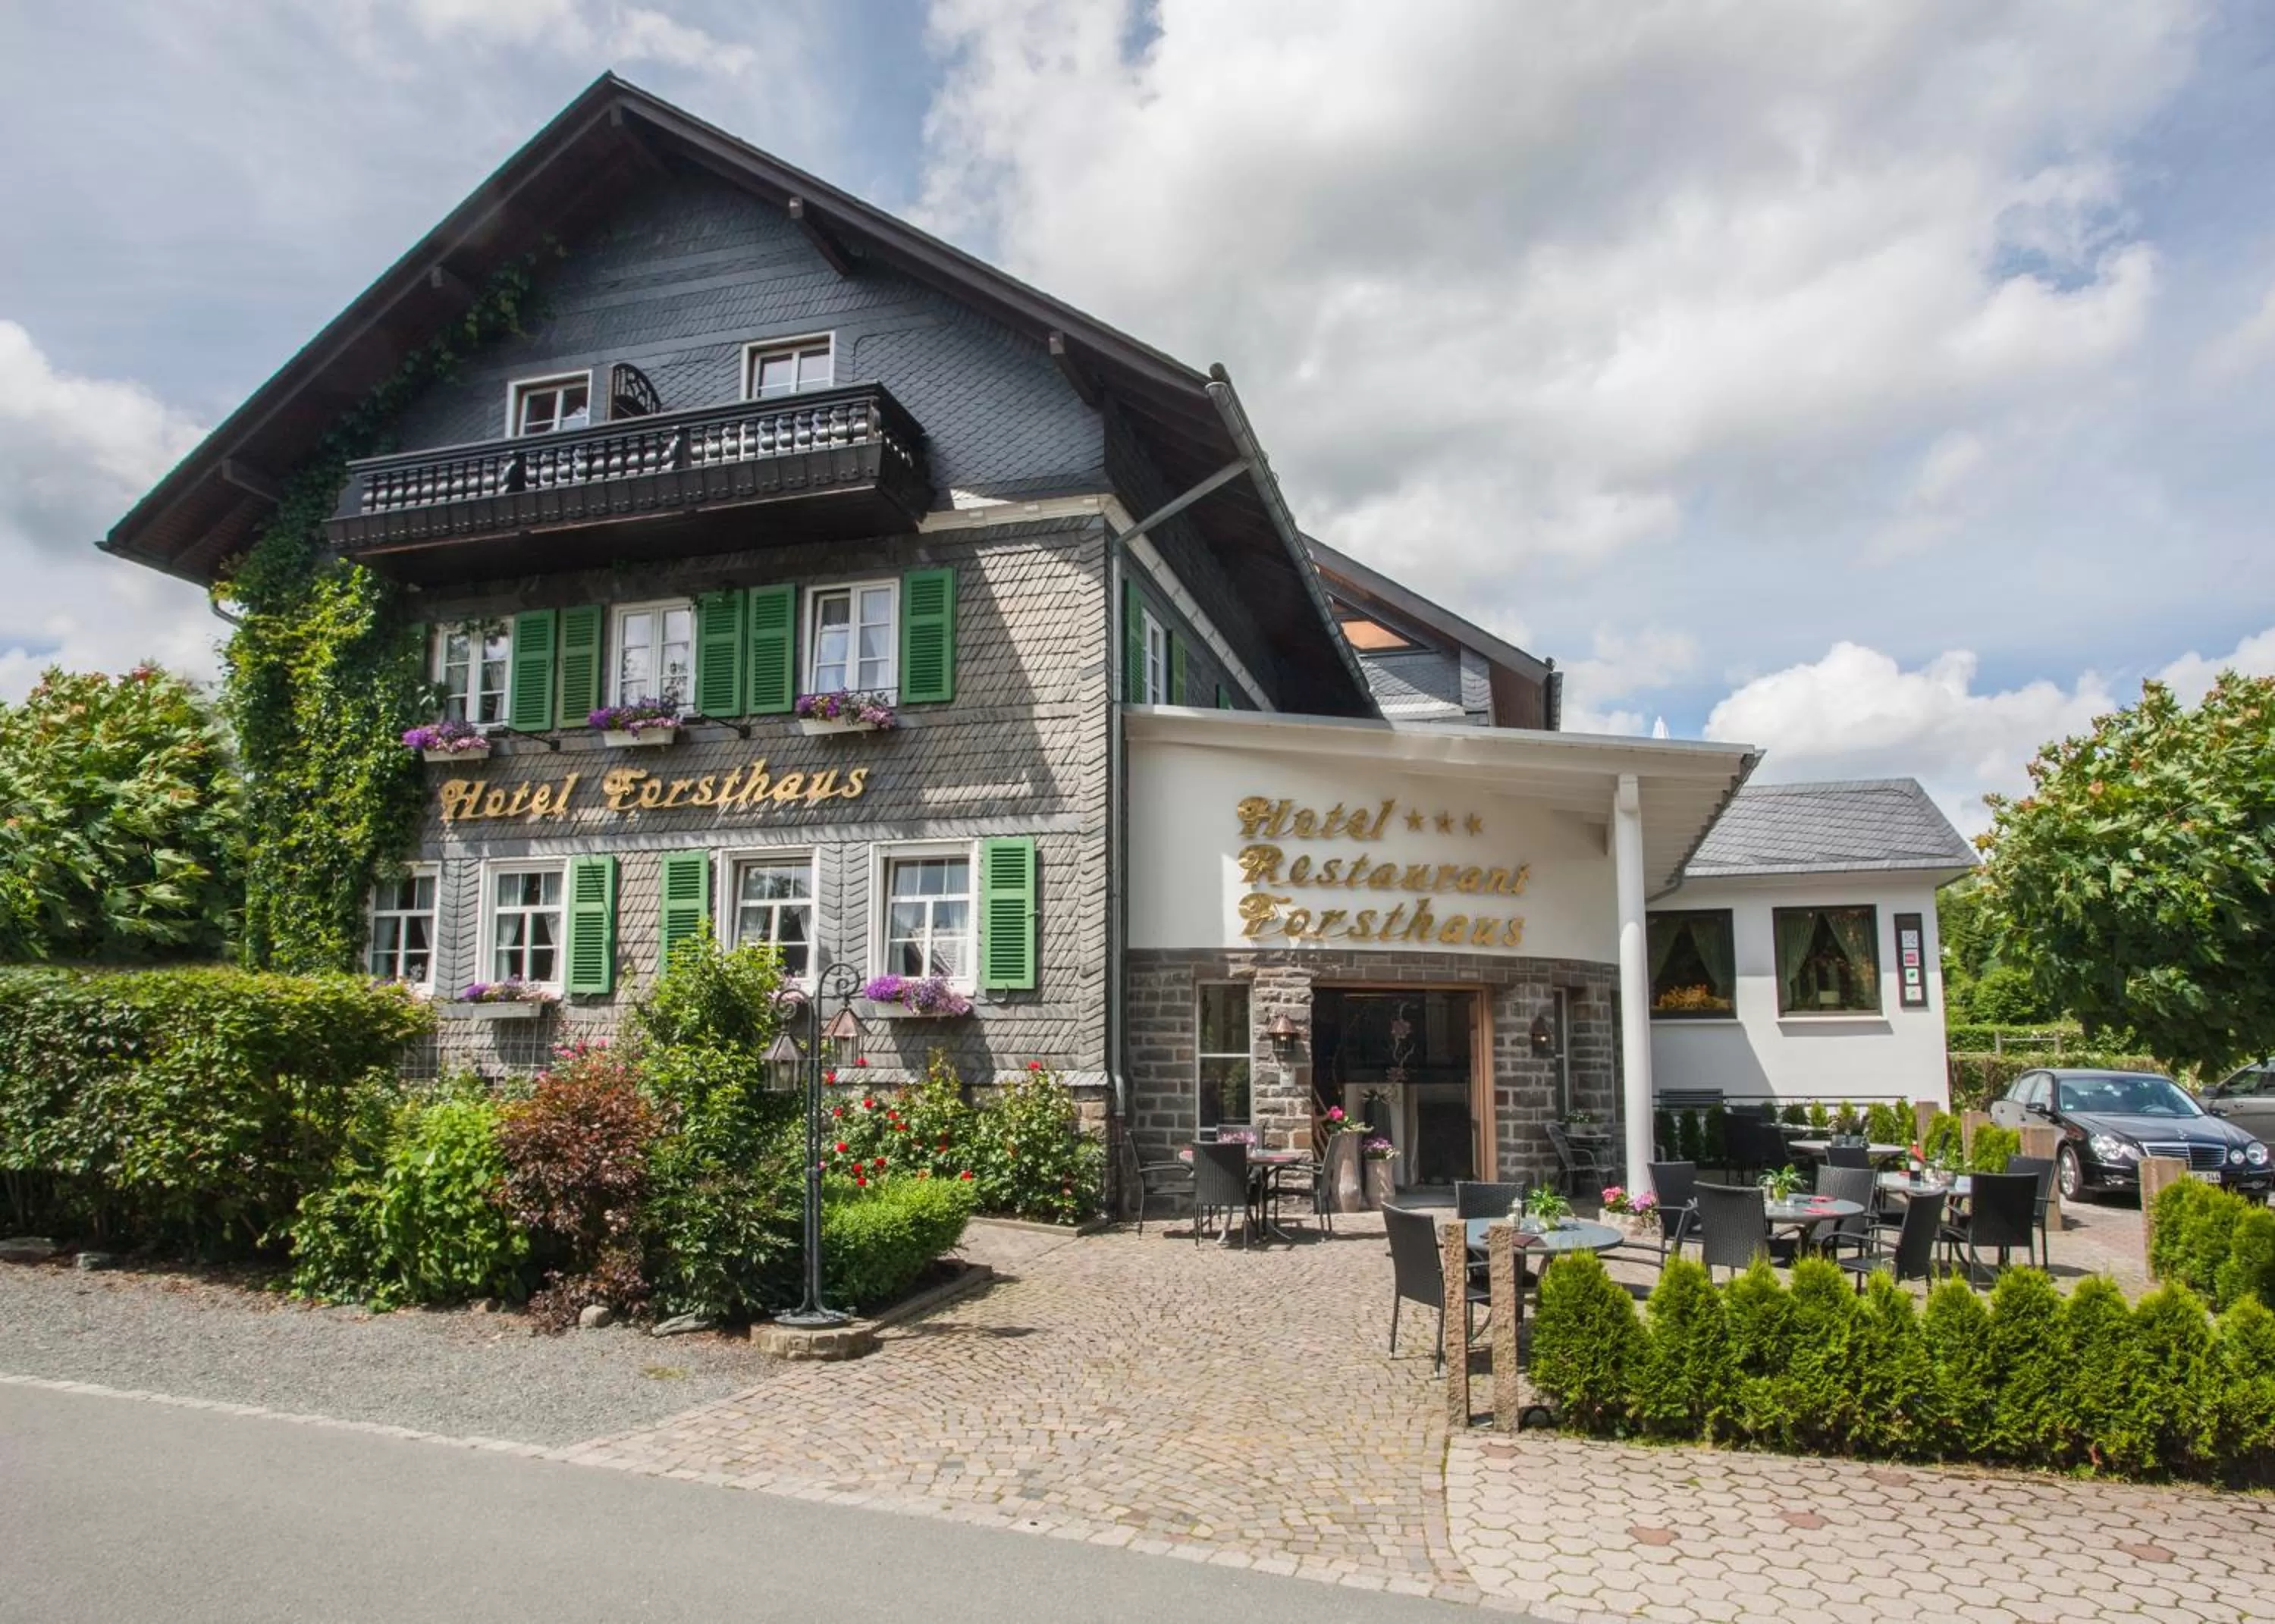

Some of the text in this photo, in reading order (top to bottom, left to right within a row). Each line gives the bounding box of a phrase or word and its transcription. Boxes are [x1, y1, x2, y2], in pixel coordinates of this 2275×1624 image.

[440, 759, 869, 820] Hotel Forsthaus
[1237, 796, 1395, 840] Hotel
[1238, 844, 1530, 894] Restaurant
[1238, 893, 1525, 946] Forsthaus
